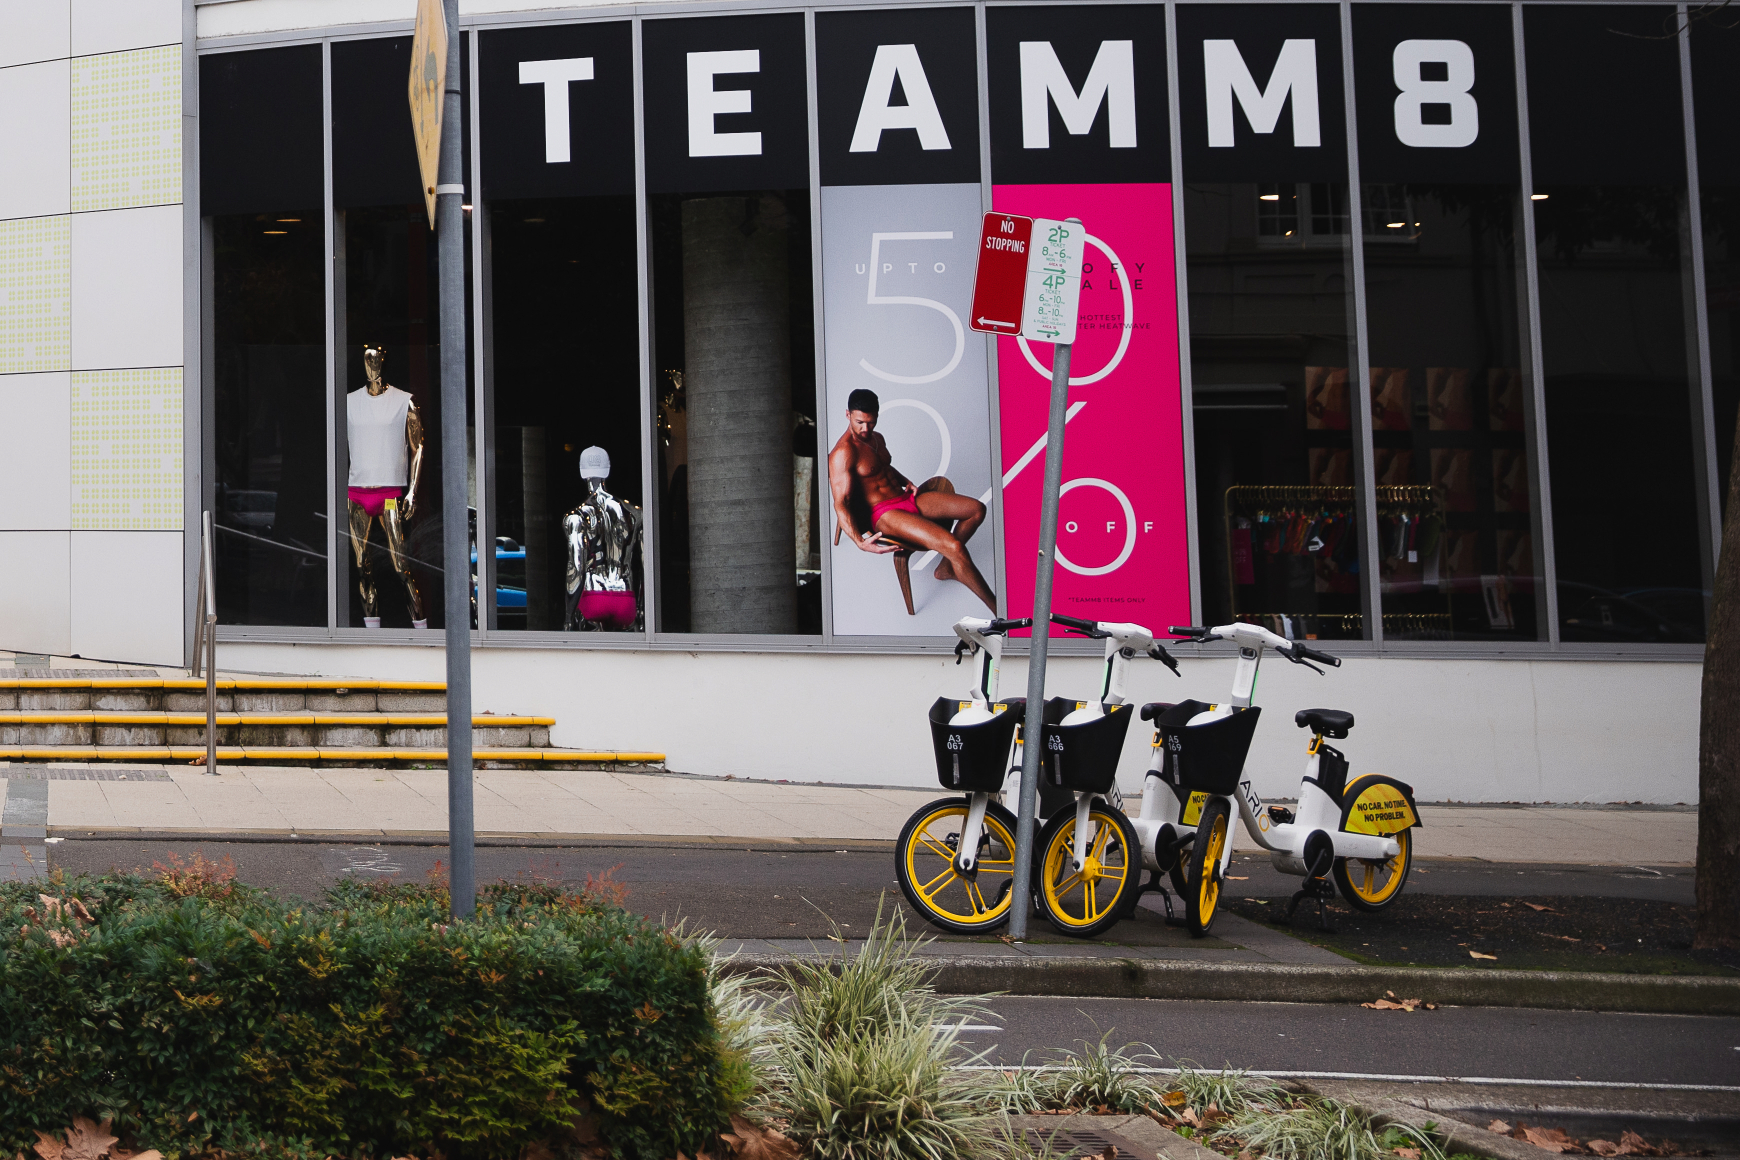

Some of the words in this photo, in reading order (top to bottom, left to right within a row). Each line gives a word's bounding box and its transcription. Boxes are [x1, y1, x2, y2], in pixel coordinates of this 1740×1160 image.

[517, 38, 1480, 163] TEAMM8
[1000, 220, 1015, 234] NO
[1047, 227, 1070, 243] 2P
[985, 236, 1025, 254] STOPPING
[1042, 274, 1066, 290] 4P
[1099, 322, 1151, 330] HEATWAVE
[1064, 520, 1154, 534] OFF
[948, 734, 962, 743] A3
[1048, 734, 1061, 743] A3
[1168, 734, 1179, 743] A5
[946, 741, 964, 751] 067
[1047, 741, 1064, 751] 666
[1167, 742, 1182, 752] 169
[1356, 802, 1368, 812] NO
[1368, 801, 1383, 811] CAR.
[1383, 800, 1394, 810] NO
[1364, 813, 1375, 823] NO
[1375, 810, 1406, 822] PROBLEM.
